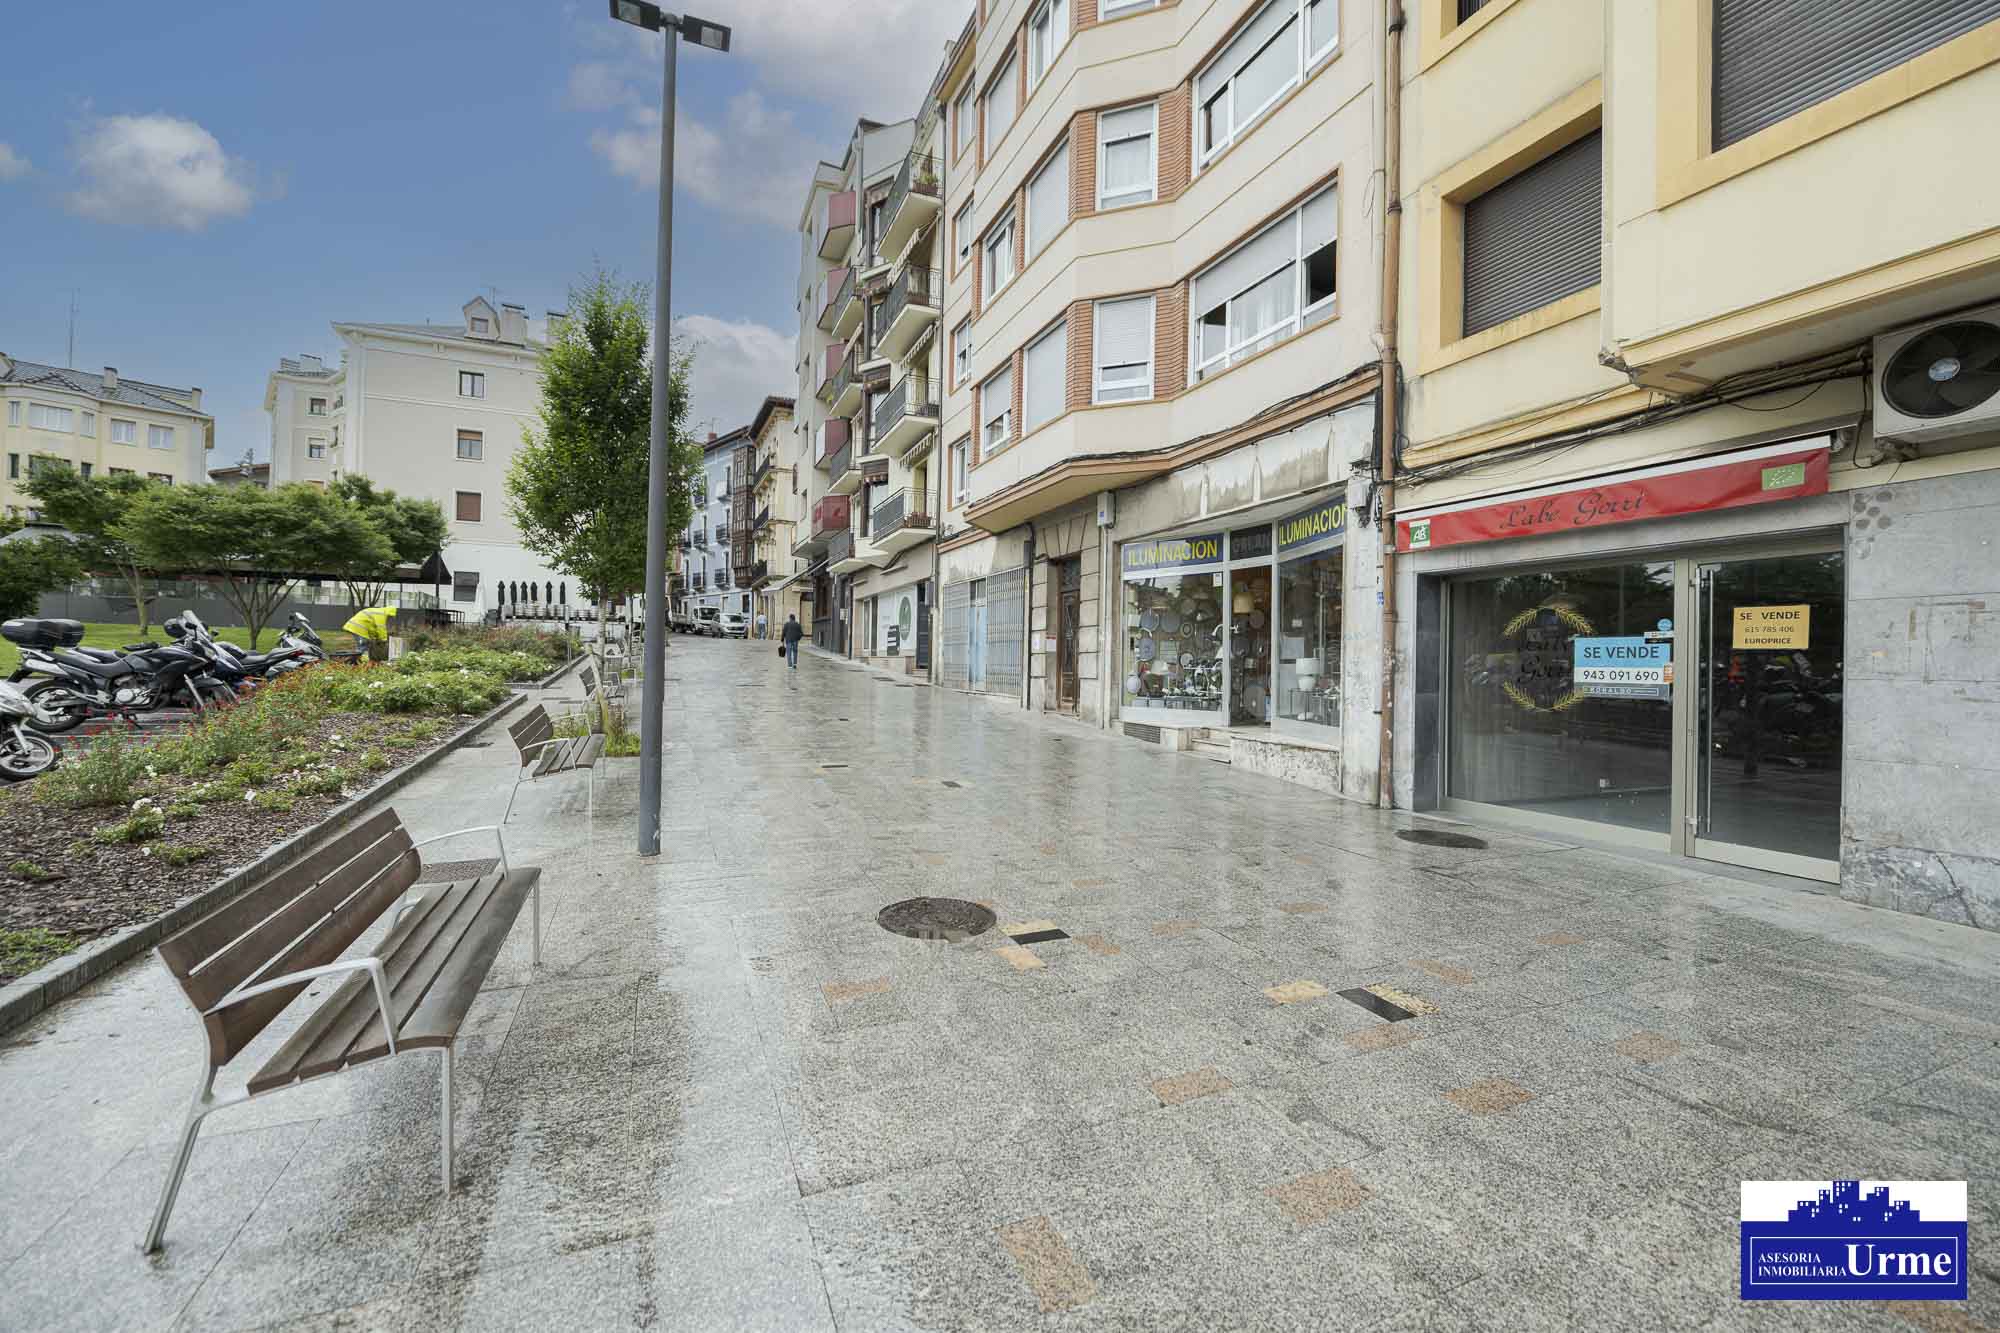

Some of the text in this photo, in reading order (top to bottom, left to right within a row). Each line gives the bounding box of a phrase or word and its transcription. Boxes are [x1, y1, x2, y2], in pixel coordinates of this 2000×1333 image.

[1128, 540, 1217, 567] ILUMINACION
[1740, 610, 1801, 621] SE VENDE
[1744, 637, 1792, 645] EUROPRICE
[1583, 646, 1601, 659] SE
[1606, 646, 1660, 659] VENDE
[1583, 670, 1605, 680] 943
[1609, 670, 1631, 681] 091
[1635, 671, 1659, 681] 690
